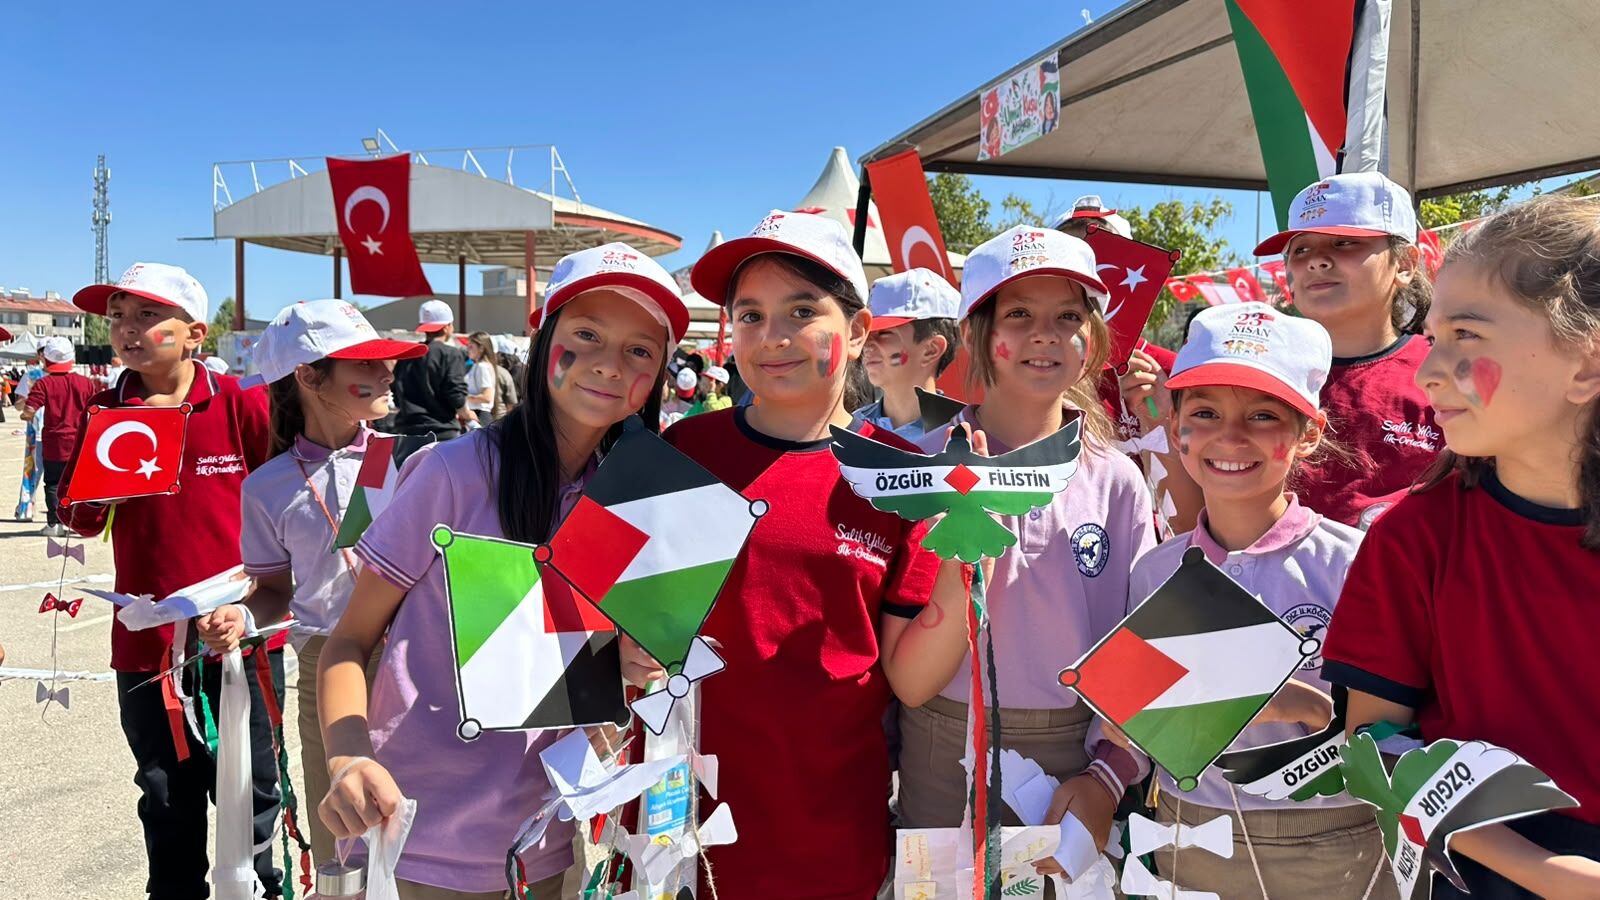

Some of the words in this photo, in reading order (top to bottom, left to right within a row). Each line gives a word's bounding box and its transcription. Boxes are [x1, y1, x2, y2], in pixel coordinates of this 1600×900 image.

[1012, 231, 1036, 247] 23
[1235, 311, 1263, 327] 23
[875, 471, 934, 492] ÖZGÜR
[988, 469, 1051, 488] FİLİSTİN
[834, 523, 866, 545] Salih
[1301, 660, 1315, 669] AN
[1281, 744, 1340, 787] ÖZGÜR
[1418, 761, 1475, 817] ÖZGÜR
